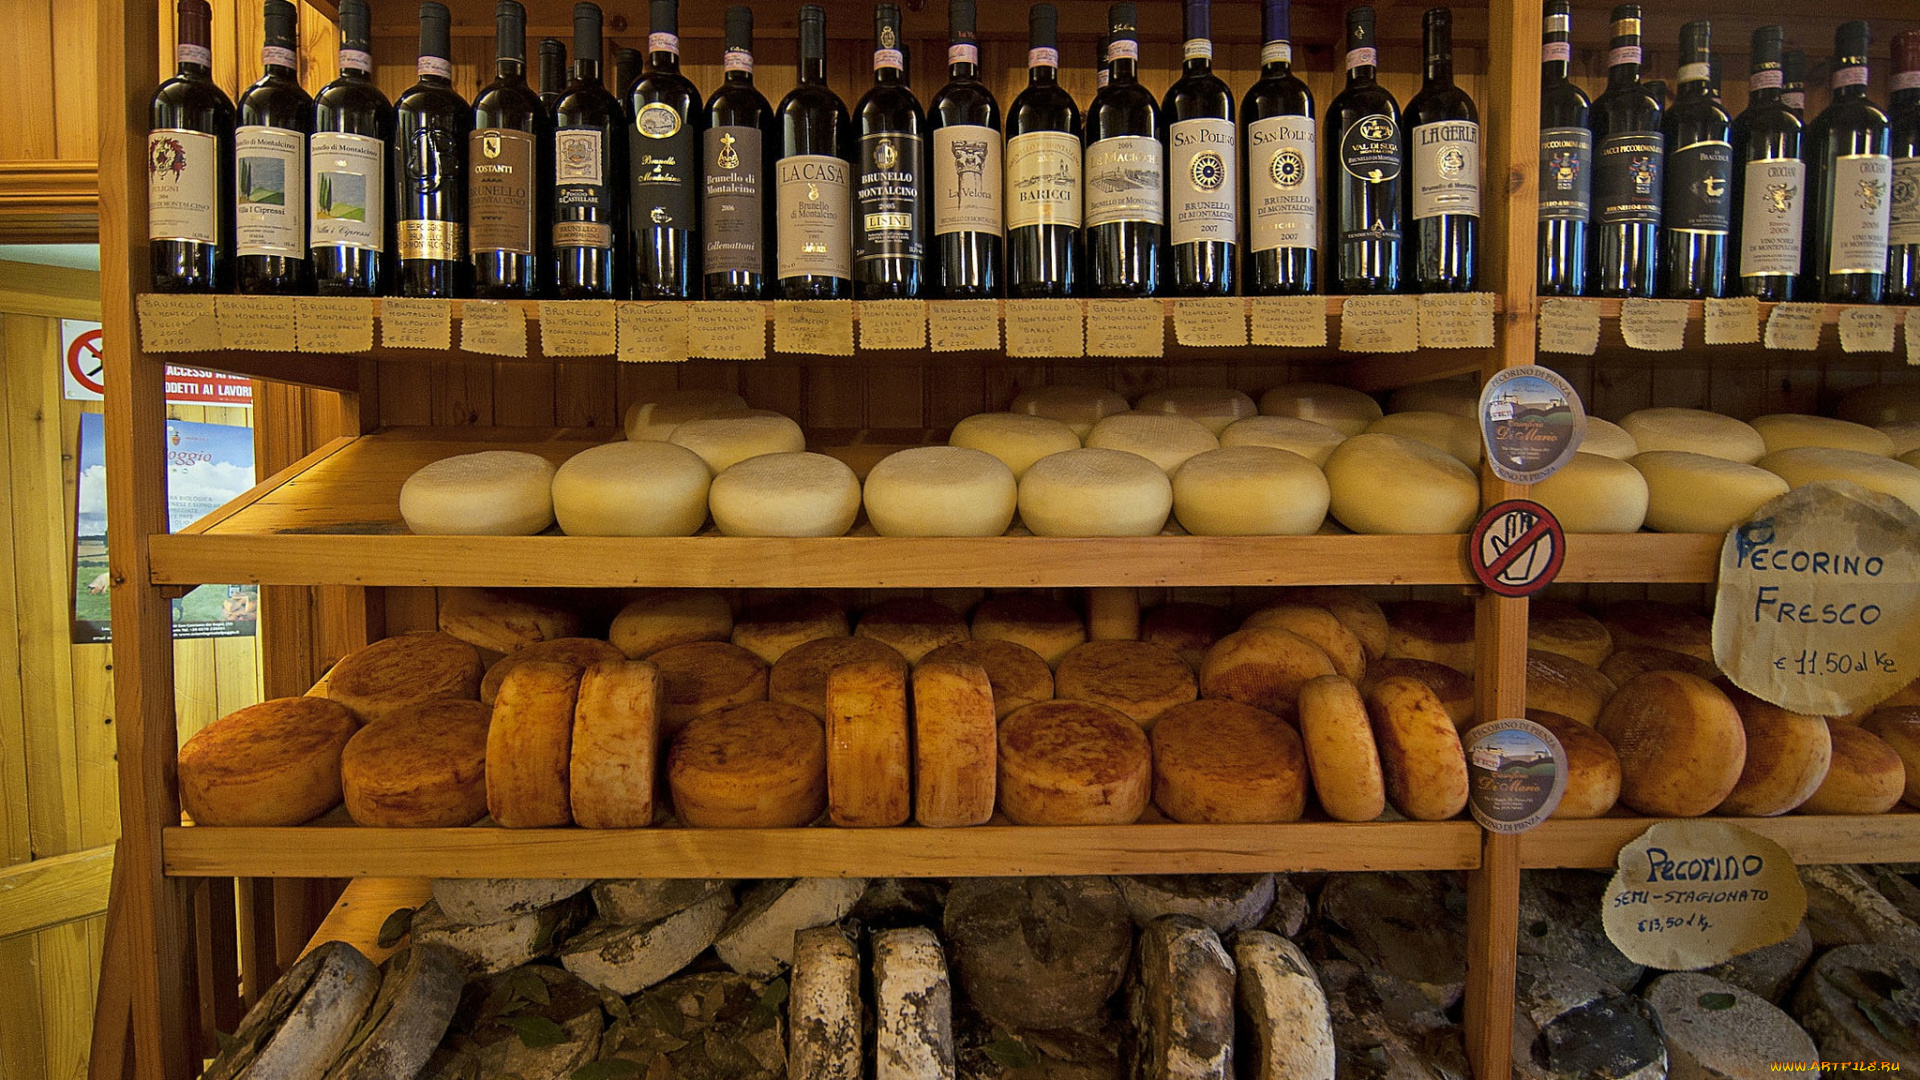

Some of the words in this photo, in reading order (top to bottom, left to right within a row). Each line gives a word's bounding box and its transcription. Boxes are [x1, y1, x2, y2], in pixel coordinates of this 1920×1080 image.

[1174, 132, 1197, 147] SAN
[1199, 129, 1235, 146] POLINO
[1253, 131, 1277, 146] SAN
[1279, 127, 1315, 143] POLINO
[1421, 128, 1440, 145] LA
[1443, 125, 1477, 142] GERLA
[257, 138, 295, 150] Montalcino
[1352, 143, 1370, 151] VAL
[1380, 143, 1398, 151] SUGA
[339, 145, 378, 157] Montalcino
[641, 155, 676, 166] Brunello
[474, 165, 513, 174] COSTANTI
[782, 166, 801, 183] LA
[803, 163, 845, 184] CASA
[637, 172, 681, 183] Montalcino
[706, 173, 743, 185] Brunello
[745, 173, 755, 183] di
[861, 172, 913, 185] BRUNELLO
[707, 184, 755, 194] Montalcino
[858, 186, 918, 199] MONTALCINO
[948, 189, 960, 199] La
[962, 187, 992, 200] Velona
[1020, 189, 1071, 202] BARICCI
[1264, 196, 1310, 205] BRUNELLO
[798, 201, 830, 211] Brunello
[1090, 198, 1117, 210] BRUNELLO
[1184, 202, 1230, 211] BRUNELLO
[1258, 207, 1267, 215] DI
[1268, 204, 1315, 214] MONTALCINO
[254, 206, 285, 215] Cipressi
[790, 210, 798, 219] di
[798, 209, 837, 220] Montalcino
[1178, 212, 1188, 220] DI
[1189, 209, 1234, 219] MONTALCINO
[869, 216, 908, 227] LISINI
[338, 226, 372, 239] Cipressi
[410, 233, 442, 241] BRUNLLO
[1281, 233, 1298, 241] 2007
[408, 241, 451, 250] MONLCINO
[707, 240, 755, 252] Collemattoni
[145, 299, 204, 309] BRUNELLO
[300, 303, 358, 311] BRUNELLO
[1010, 304, 1059, 312] BRUNELLO
[1092, 304, 1147, 313] BRUNELLO
[1347, 299, 1402, 308] BRUNELLO
[1423, 299, 1477, 307] BRUNELLO
[545, 306, 602, 317] BRUNELLO
[1361, 309, 1413, 317] MONTALCINO
[1427, 310, 1489, 318] MONTALCINO
[1017, 315, 1073, 323] MONTALCINO
[1490, 368, 1534, 388] PECORINO
[1534, 370, 1545, 378] DI
[1544, 373, 1571, 398] PIENZA
[165, 382, 199, 394] DDETTI
[202, 383, 214, 395] AI
[217, 384, 252, 397] LAVORI
[1520, 428, 1559, 441] Mario
[168, 450, 212, 466] oggio
[1528, 466, 1556, 482] PIENZA
[1735, 515, 1884, 577] PECORINO
[1754, 586, 1882, 626] FRESCO
[1773, 656, 1786, 670] €
[1794, 650, 1852, 676] 11.50
[1471, 721, 1517, 738] PECORINO
[1518, 722, 1529, 731] DI
[1530, 725, 1557, 747] PIENZA
[1503, 822, 1513, 831] DI
[1514, 815, 1541, 831] PIENZA
[1614, 888, 1770, 908] SEMI-STAGIONATO
